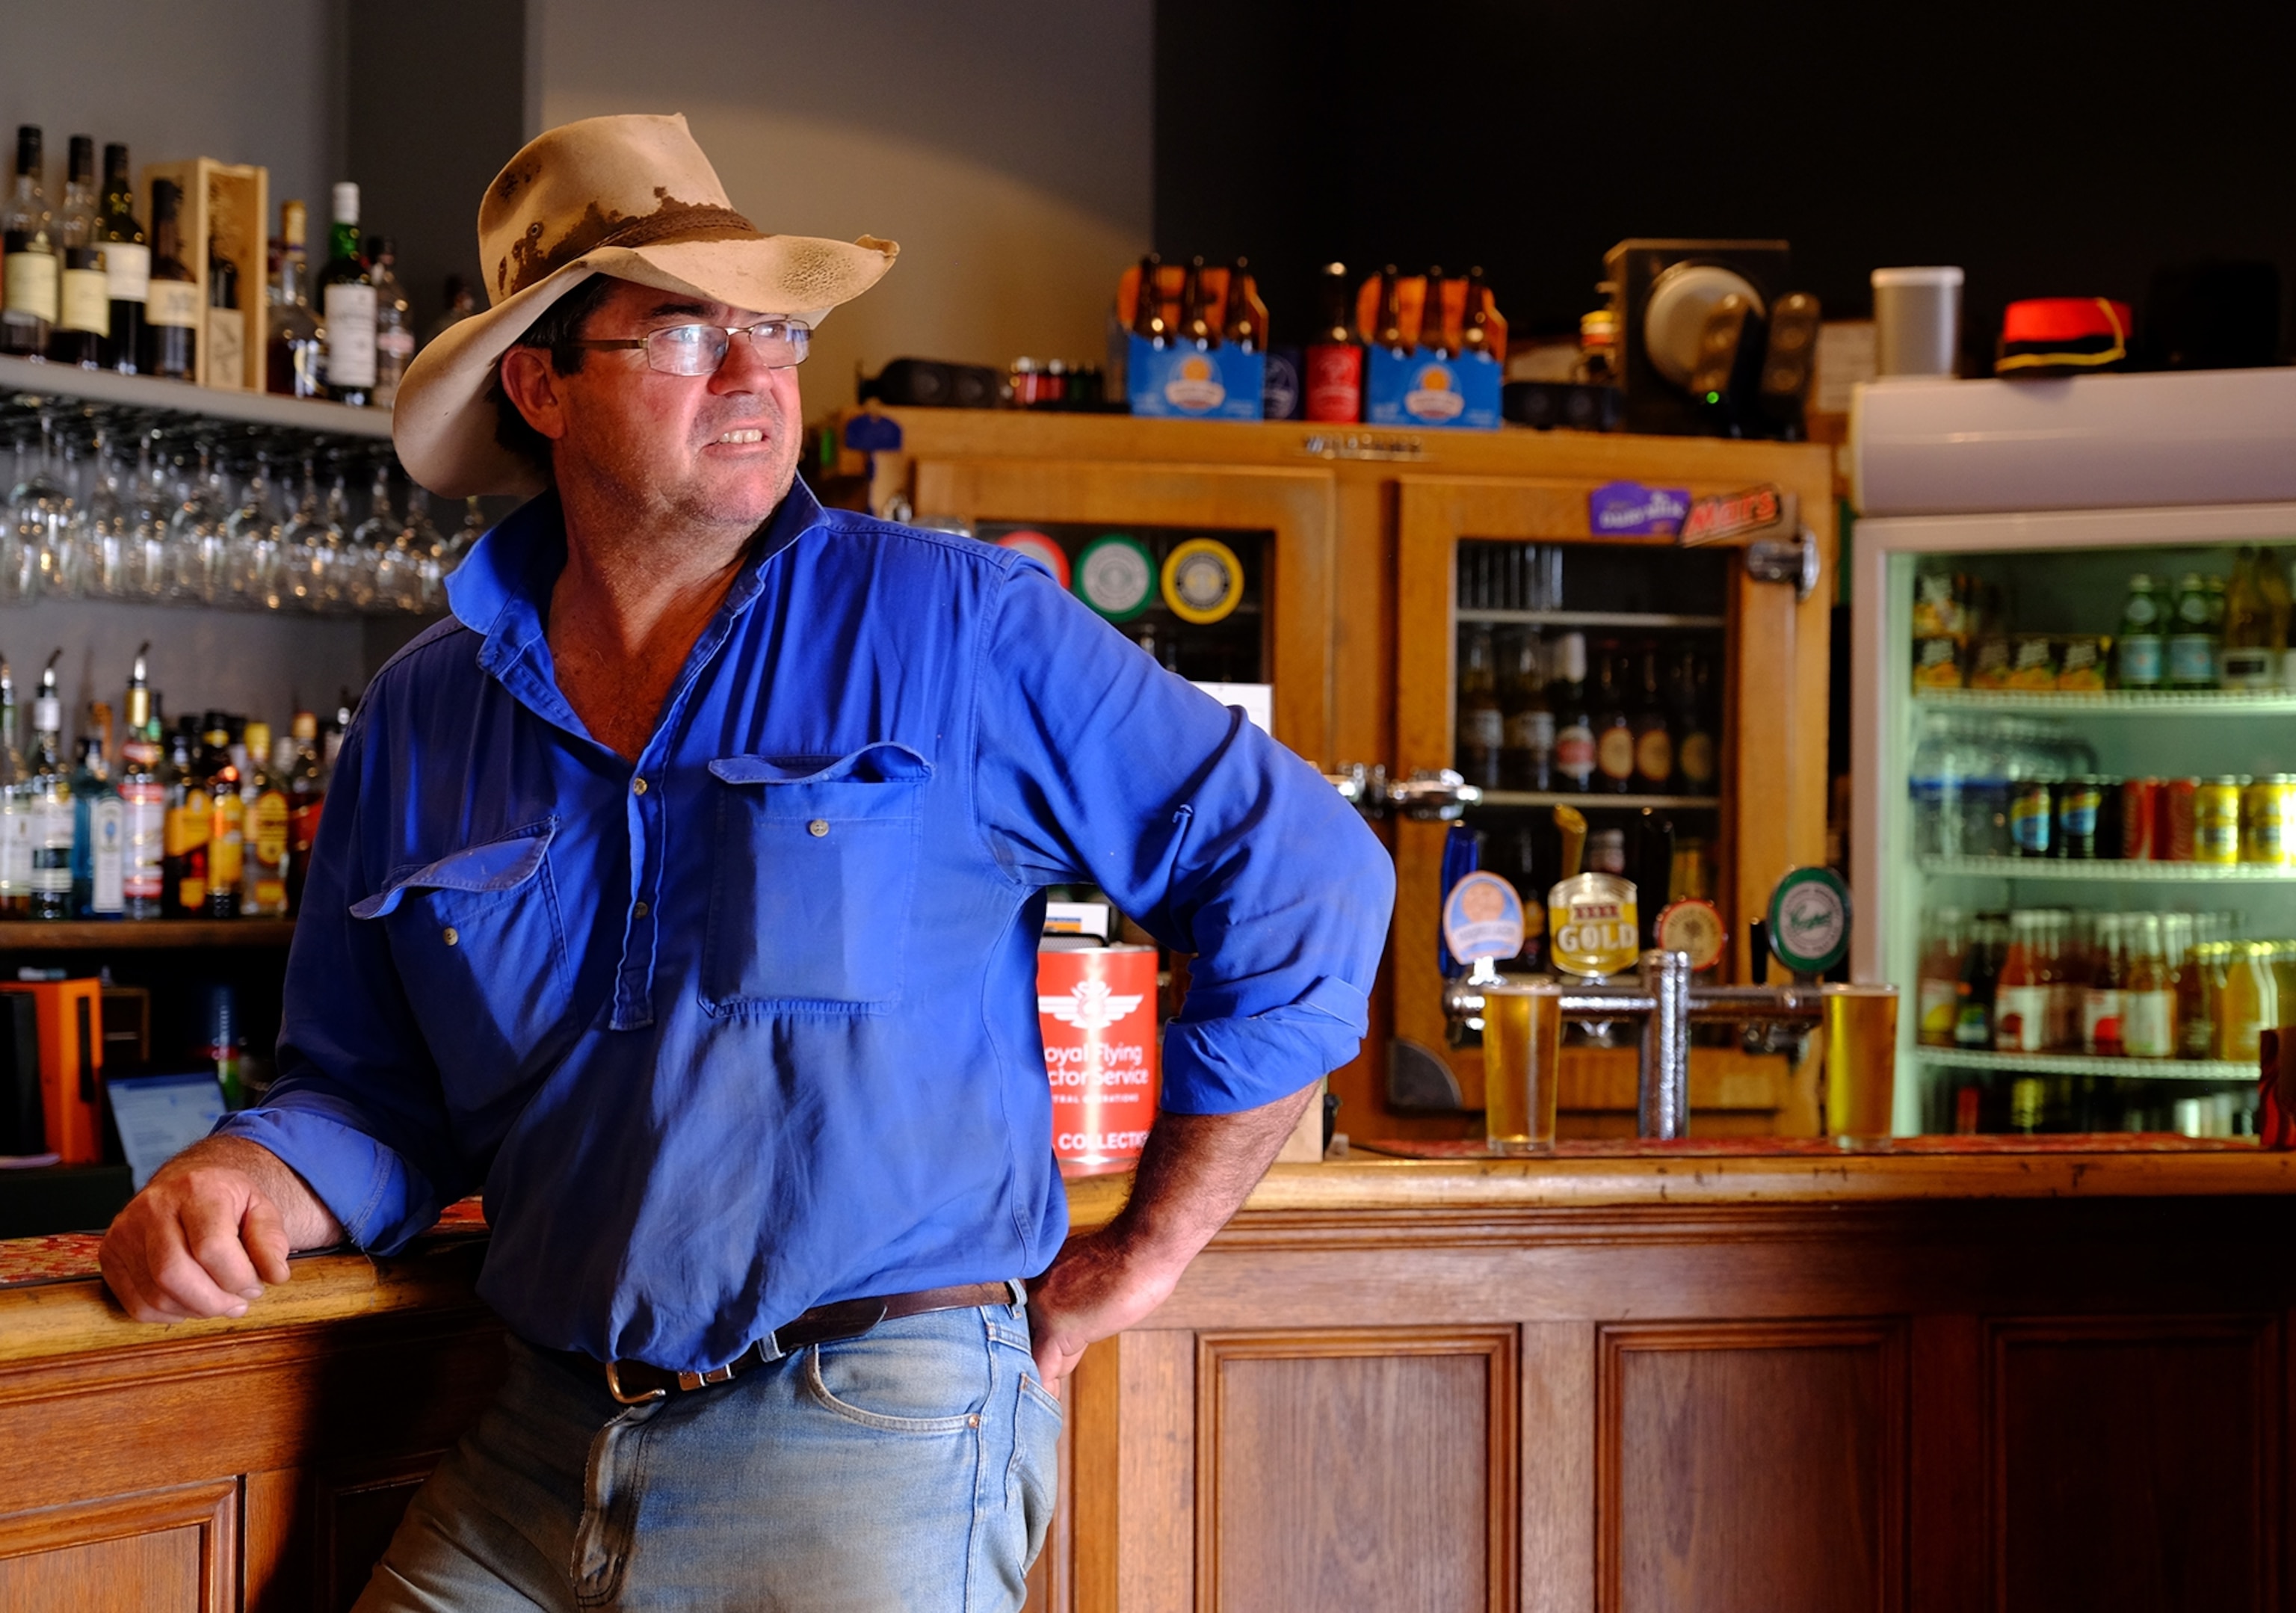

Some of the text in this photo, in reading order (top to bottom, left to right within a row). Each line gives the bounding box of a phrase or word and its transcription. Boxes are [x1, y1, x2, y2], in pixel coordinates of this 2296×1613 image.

[1683, 490, 1777, 539] Mars
[1557, 923, 1638, 953] GOLD
[1044, 1041, 1143, 1067] oyal Flying
[1048, 1064, 1149, 1086] ctor Service
